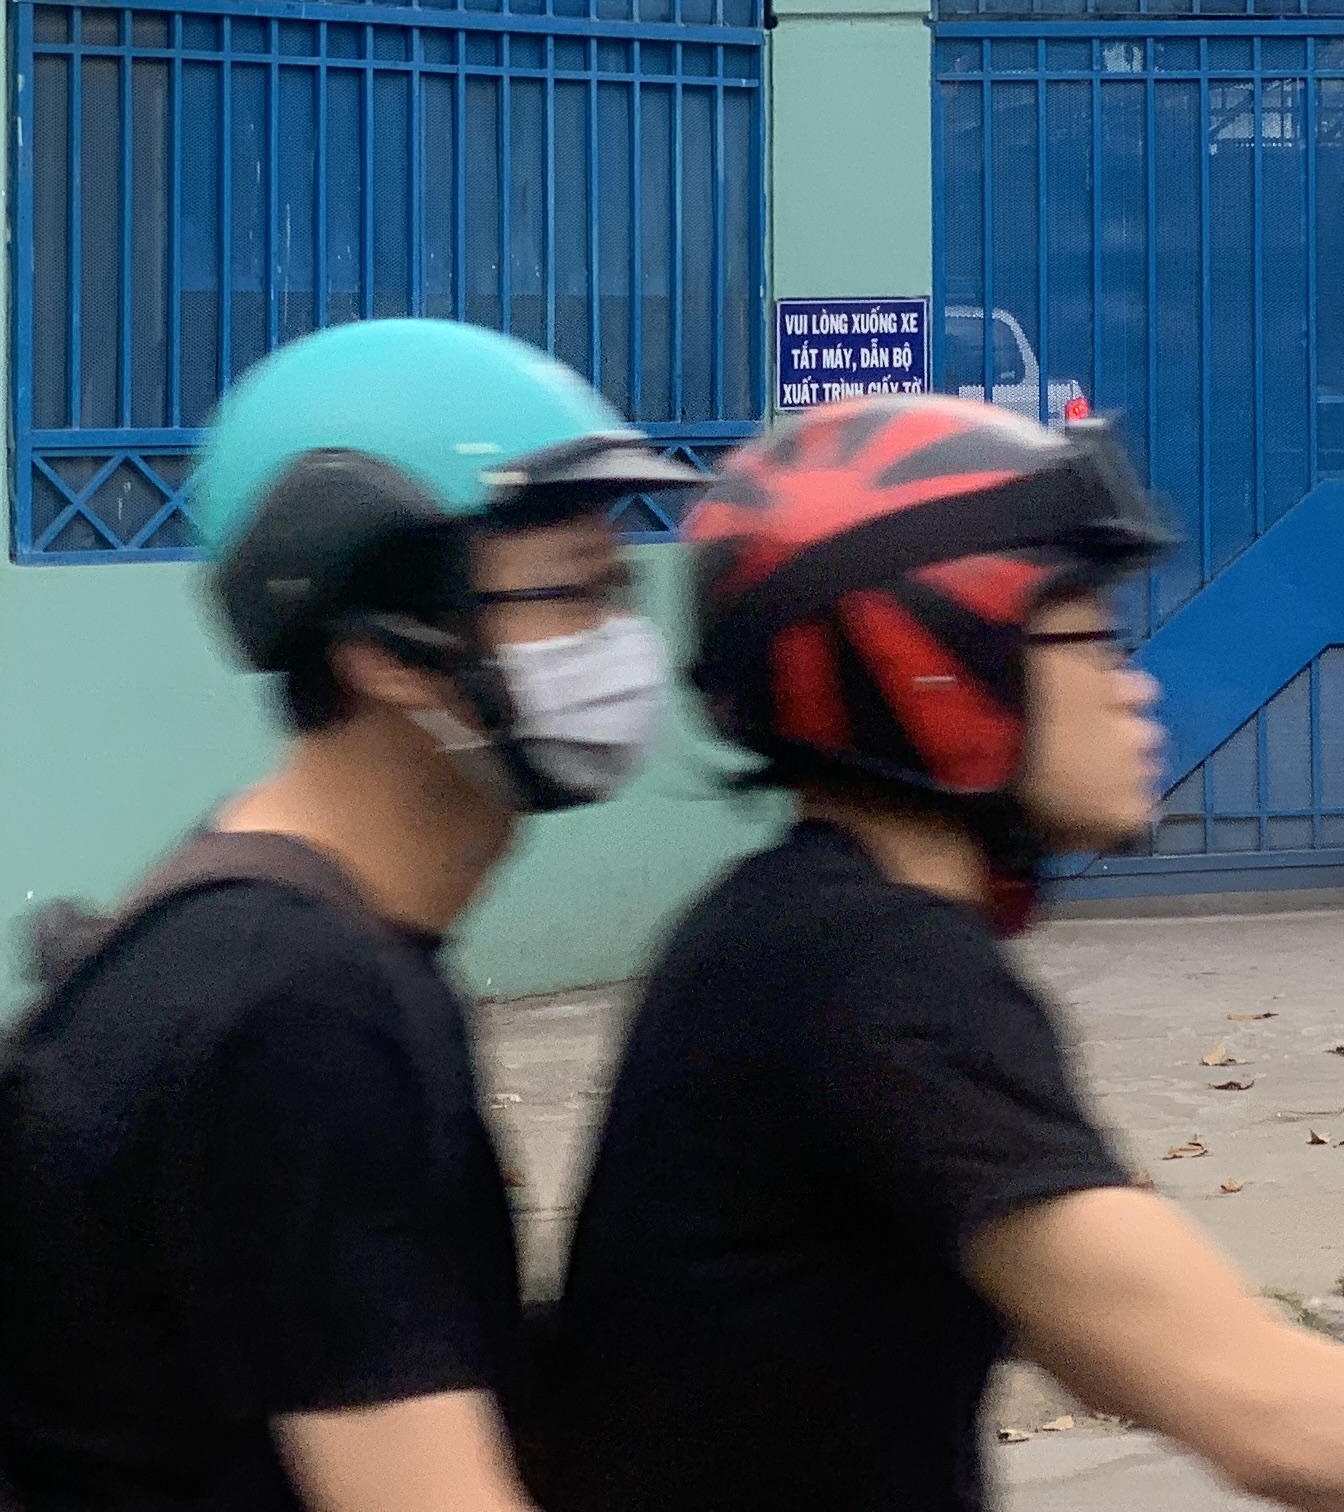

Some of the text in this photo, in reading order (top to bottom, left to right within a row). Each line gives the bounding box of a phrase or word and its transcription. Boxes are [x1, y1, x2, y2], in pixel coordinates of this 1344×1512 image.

[784, 305, 919, 335] VUI LÒNG XUỐNG XE
[791, 338, 913, 372] TẮT MÁY, DẪN BỘ
[783, 375, 819, 405] XUẤT
